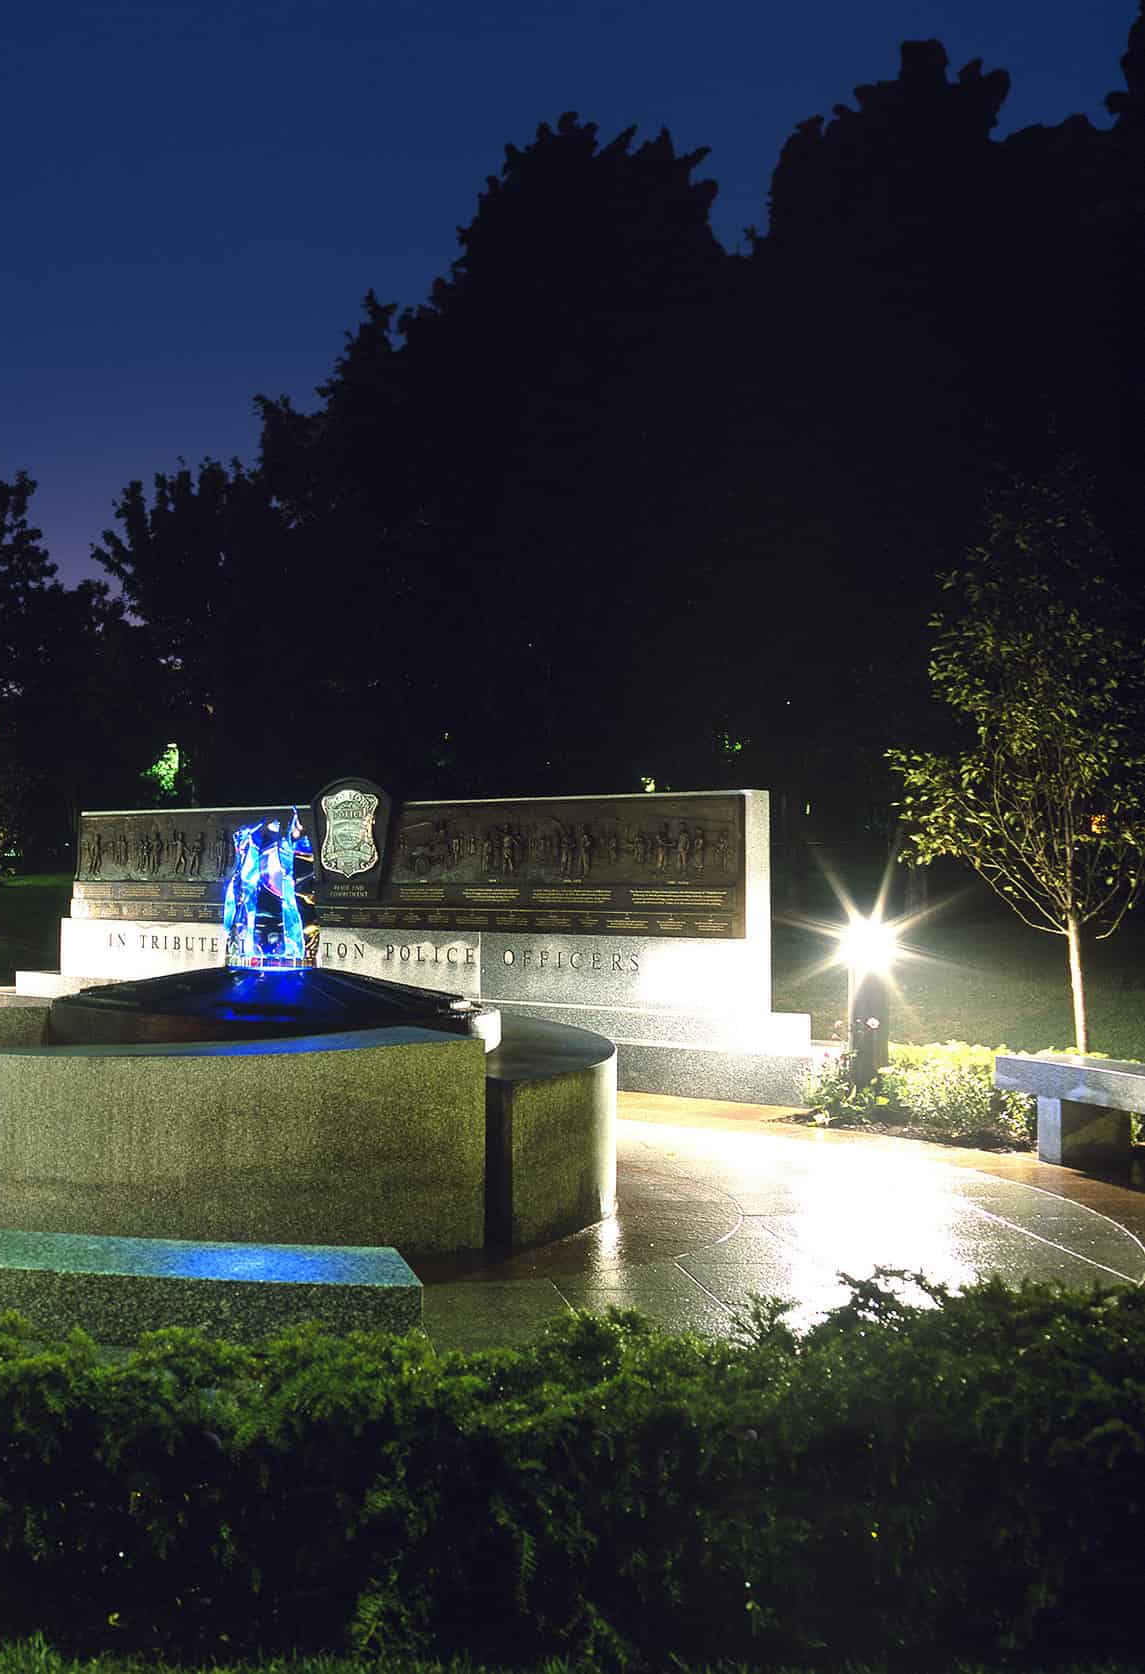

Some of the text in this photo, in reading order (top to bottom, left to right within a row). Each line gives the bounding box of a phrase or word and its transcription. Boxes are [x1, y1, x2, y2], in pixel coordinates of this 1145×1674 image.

[139, 935, 219, 953] TRIBUTE
[385, 945, 476, 964] POLICE
[502, 949, 641, 972] OFFICERS
